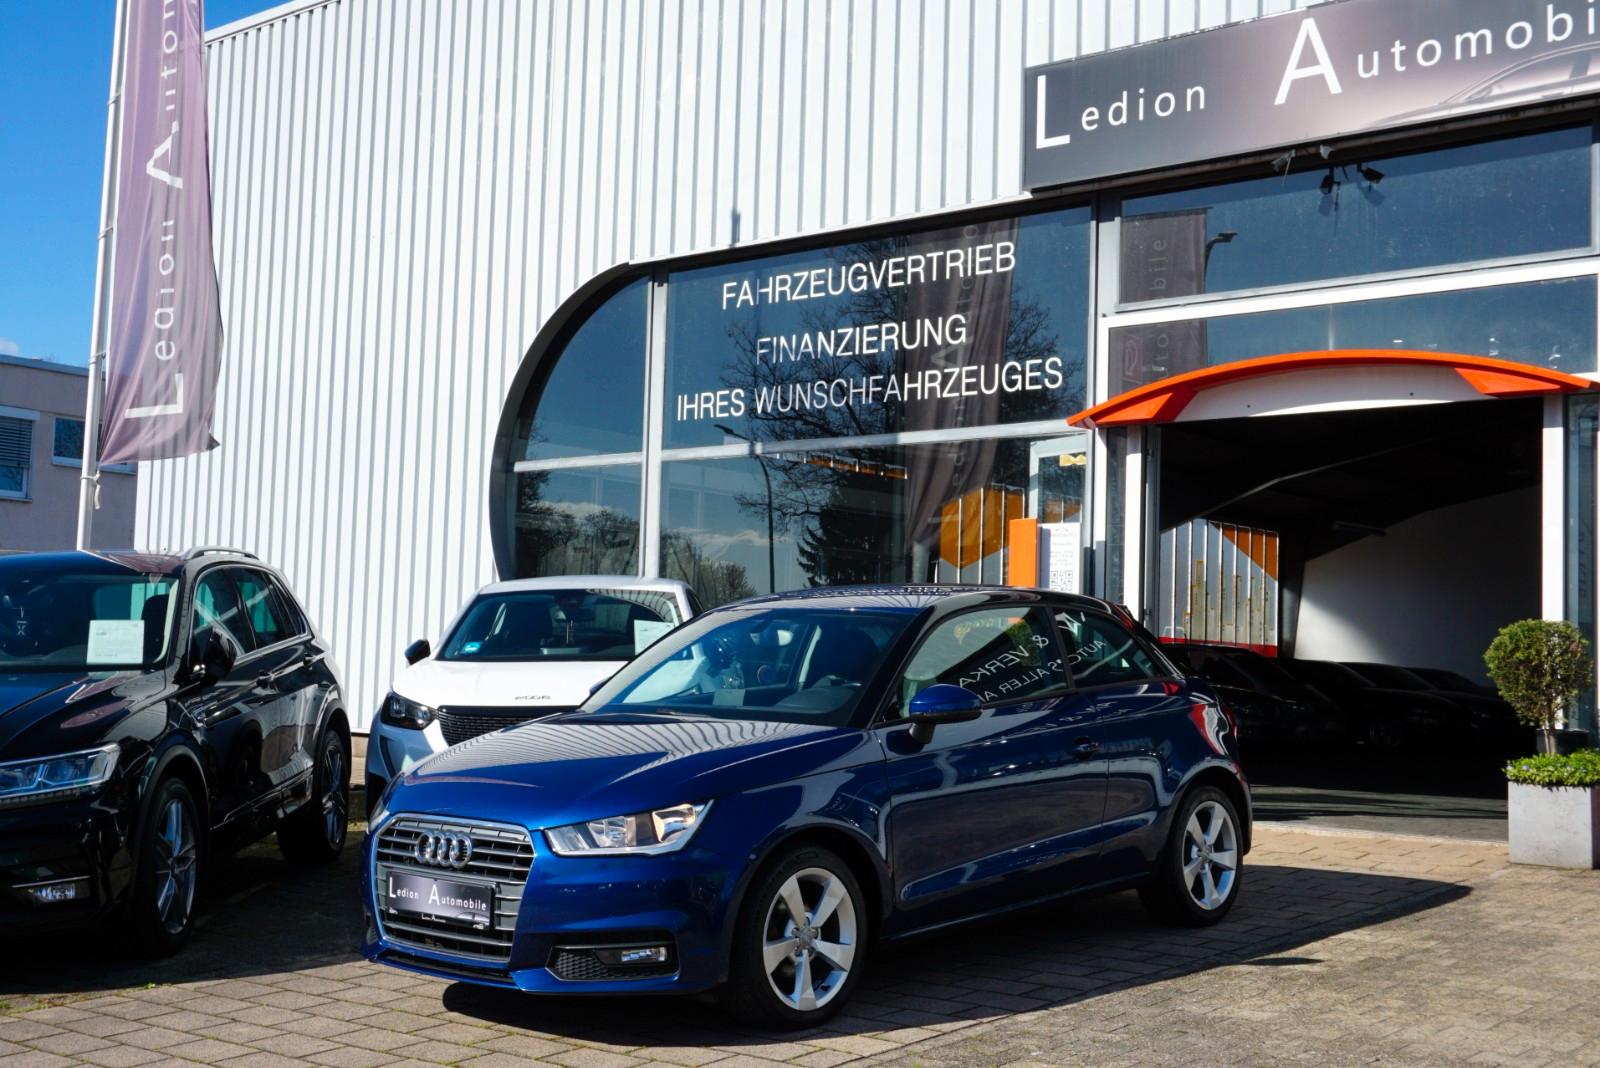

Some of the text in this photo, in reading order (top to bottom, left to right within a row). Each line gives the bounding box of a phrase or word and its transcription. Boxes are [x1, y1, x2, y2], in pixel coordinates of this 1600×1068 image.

[1036, 74, 1206, 149] Ledion
[722, 241, 1016, 310] FAHRZEUGVERTRIEB
[756, 314, 967, 365] FINANZIERUNG
[677, 357, 1063, 421] IHRES WUNSCHFAHRZEUGES
[389, 876, 487, 911] Ledion Automobile
